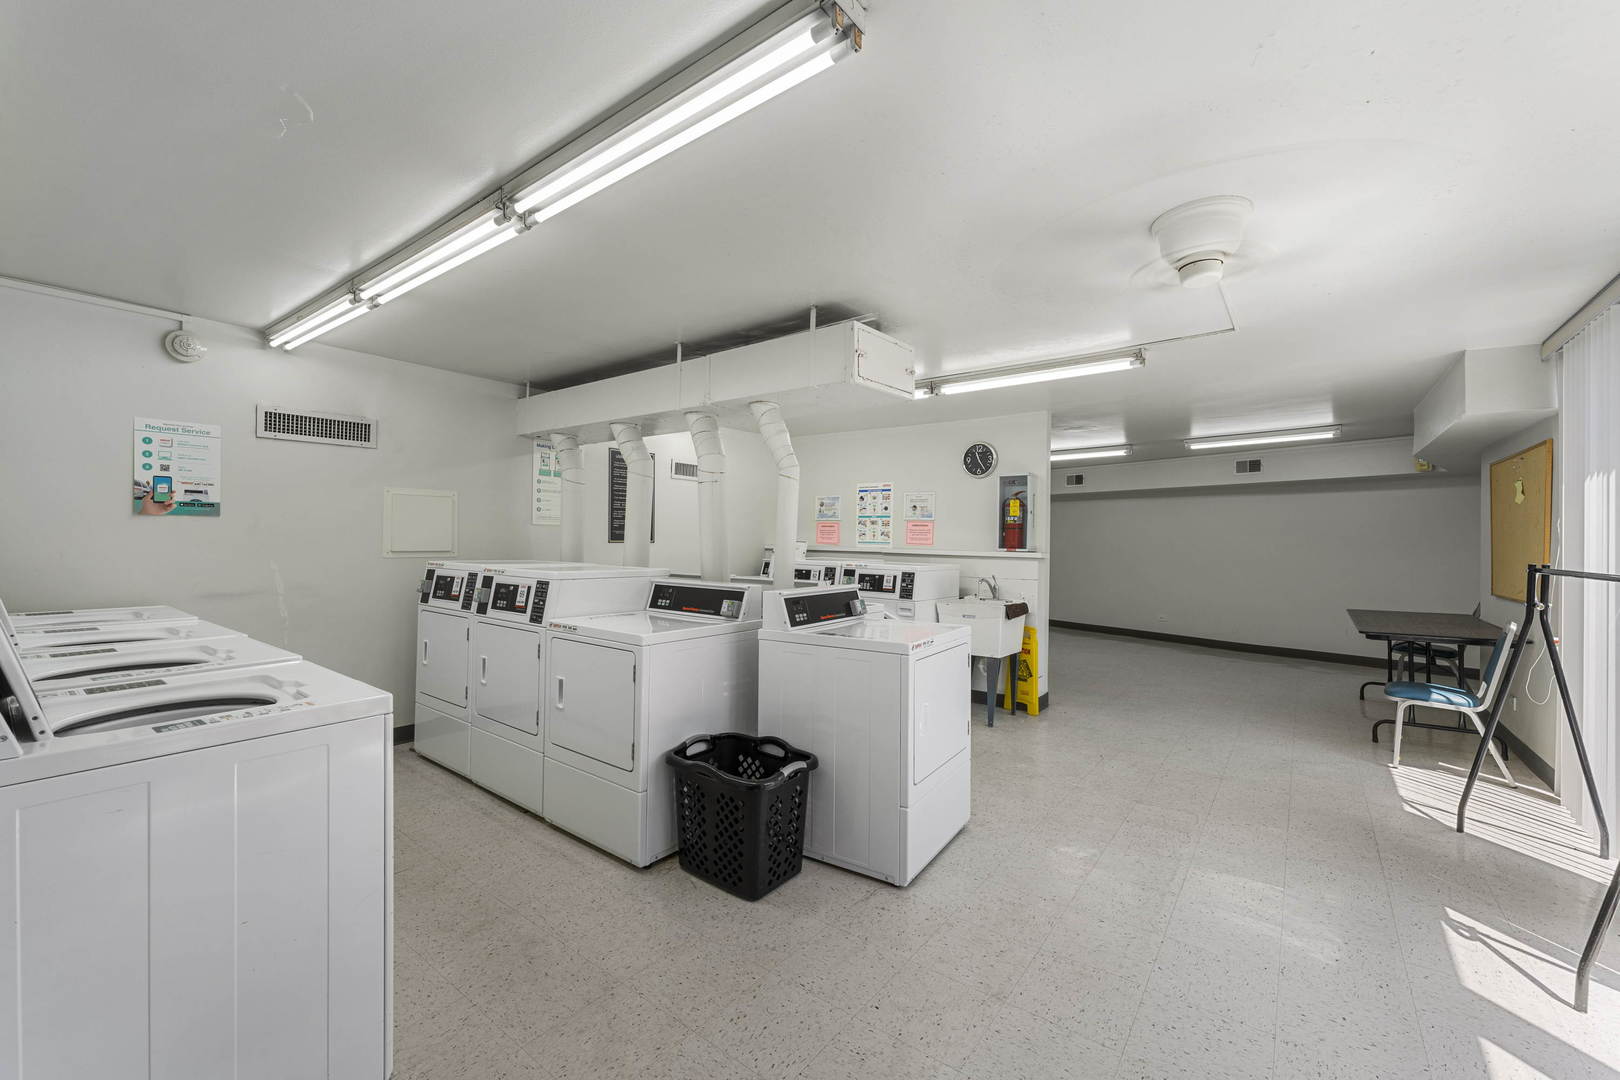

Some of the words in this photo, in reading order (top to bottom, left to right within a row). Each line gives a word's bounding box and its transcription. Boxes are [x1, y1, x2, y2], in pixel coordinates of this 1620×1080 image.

[144, 424, 179, 433] Request
[536, 442, 551, 450] Making
[987, 455, 992, 463] 3
